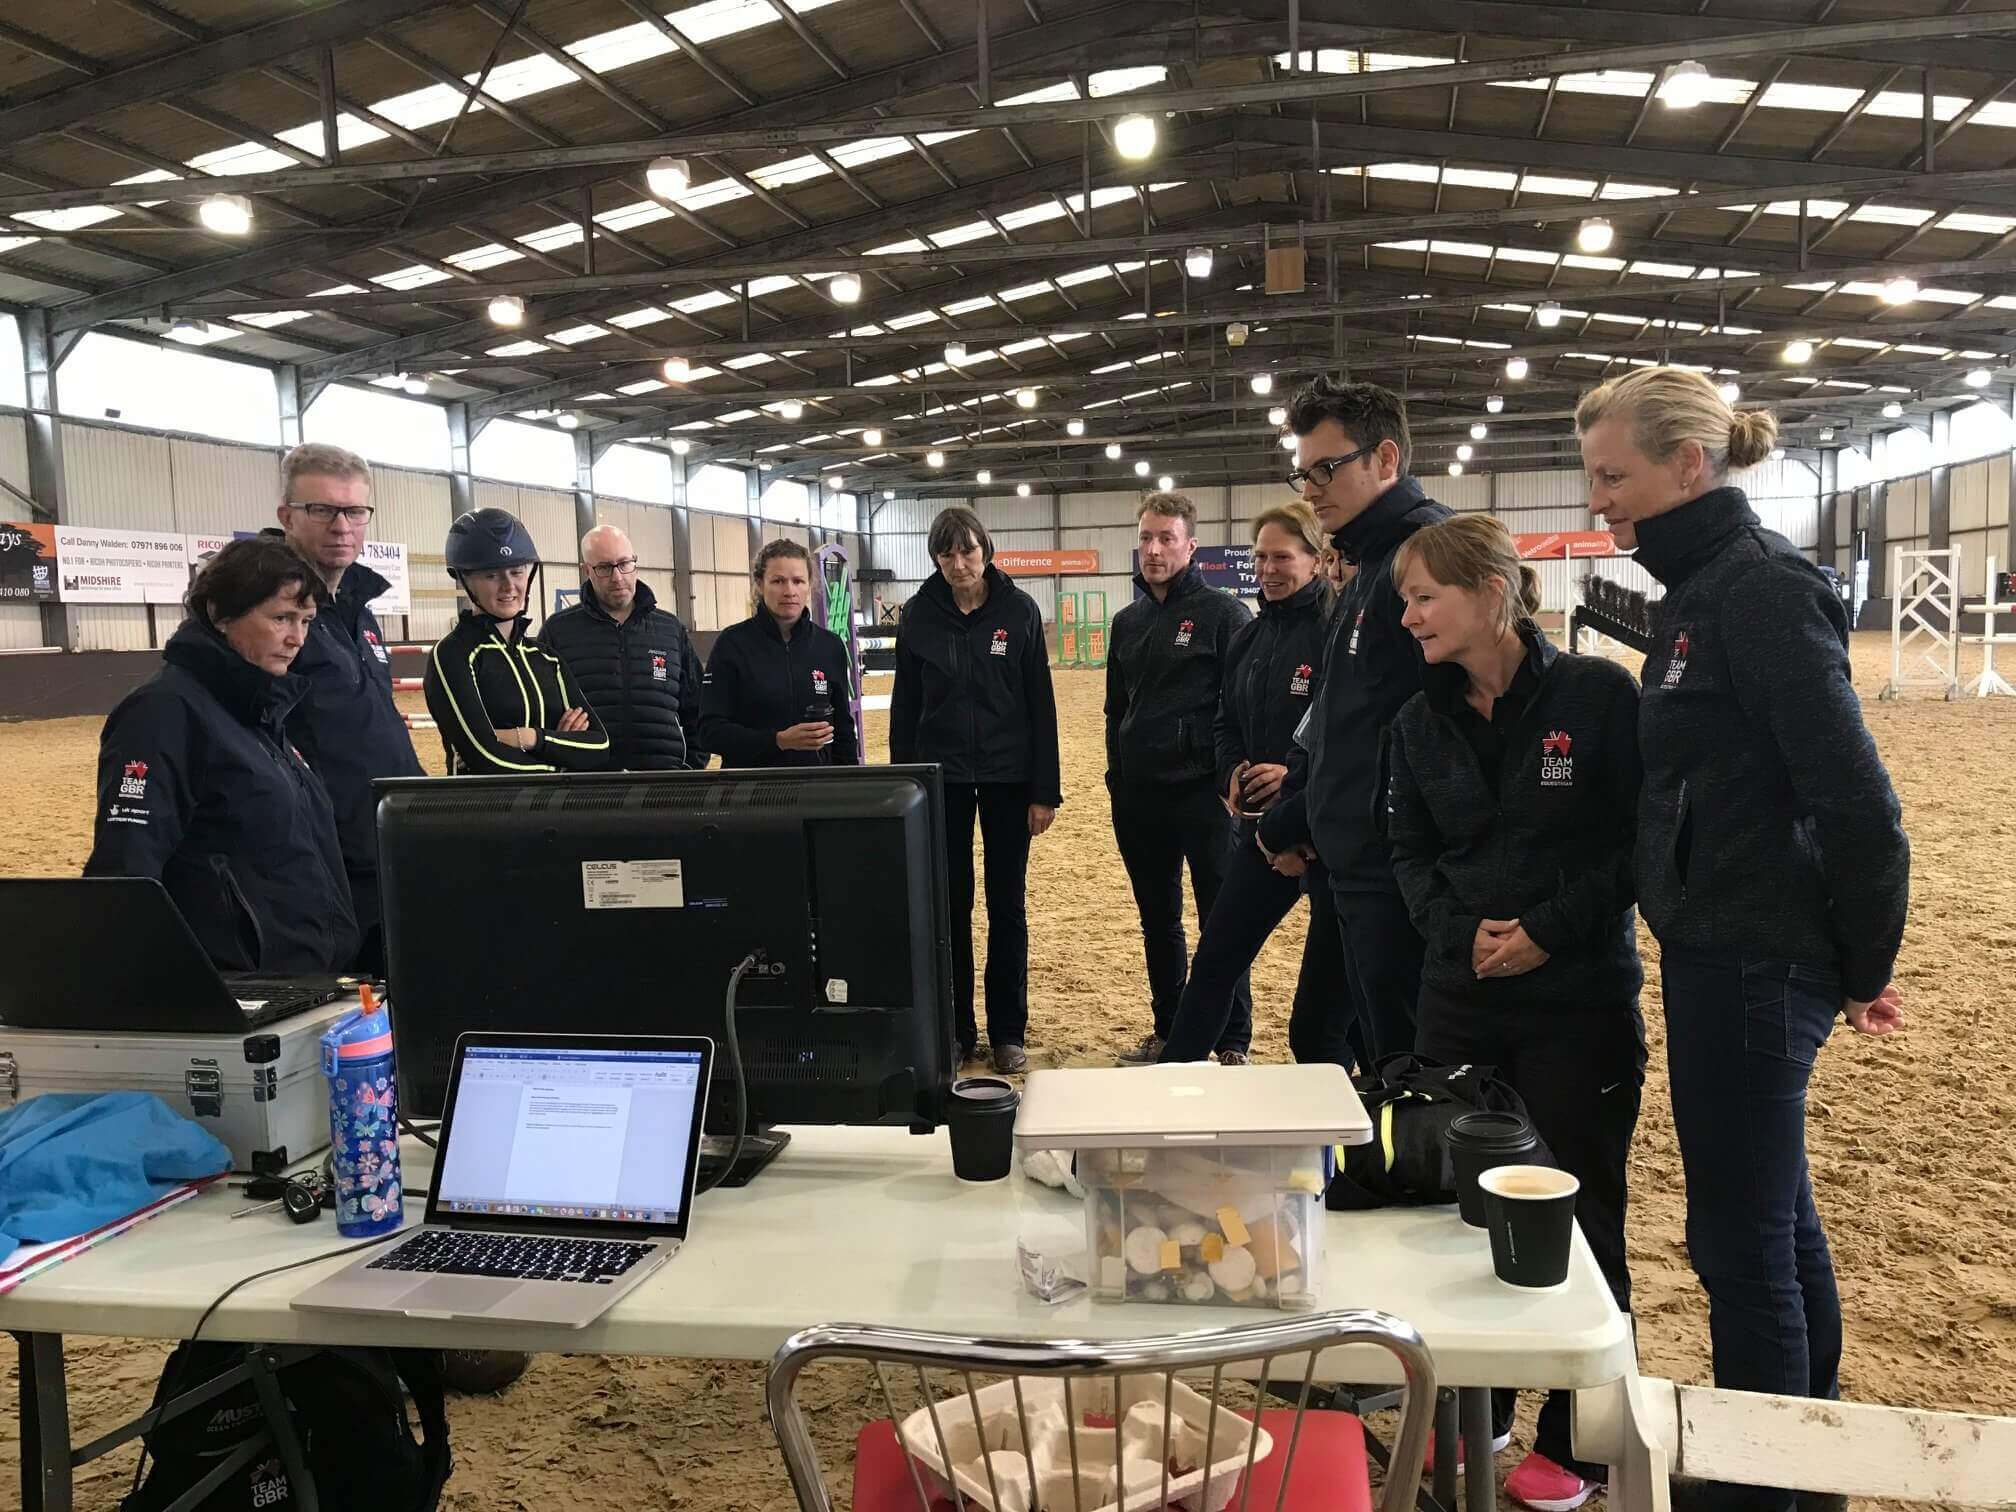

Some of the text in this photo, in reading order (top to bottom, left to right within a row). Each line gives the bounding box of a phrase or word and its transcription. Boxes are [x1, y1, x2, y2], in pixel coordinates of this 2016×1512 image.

[60, 537, 183, 551] Call Danny Walden: 07971 896 006
[367, 544, 401, 560] 783404
[75, 557, 85, 565] FOR
[1236, 561, 1255, 570] For
[80, 576, 122, 586] MIDSHIRE
[14, 587, 30, 597] 080
[1669, 659, 1687, 671] TEAM
[1292, 677, 1310, 685] TEAM
[1664, 669, 1683, 684] GBR
[1290, 683, 1309, 692] GBR
[1541, 756, 1573, 767] TEAM
[1541, 766, 1572, 780] GBR
[122, 777, 147, 787] TEAM
[120, 784, 145, 795] GBR
[251, 1475, 287, 1495] TEAM
[254, 1486, 289, 1508] GBR
